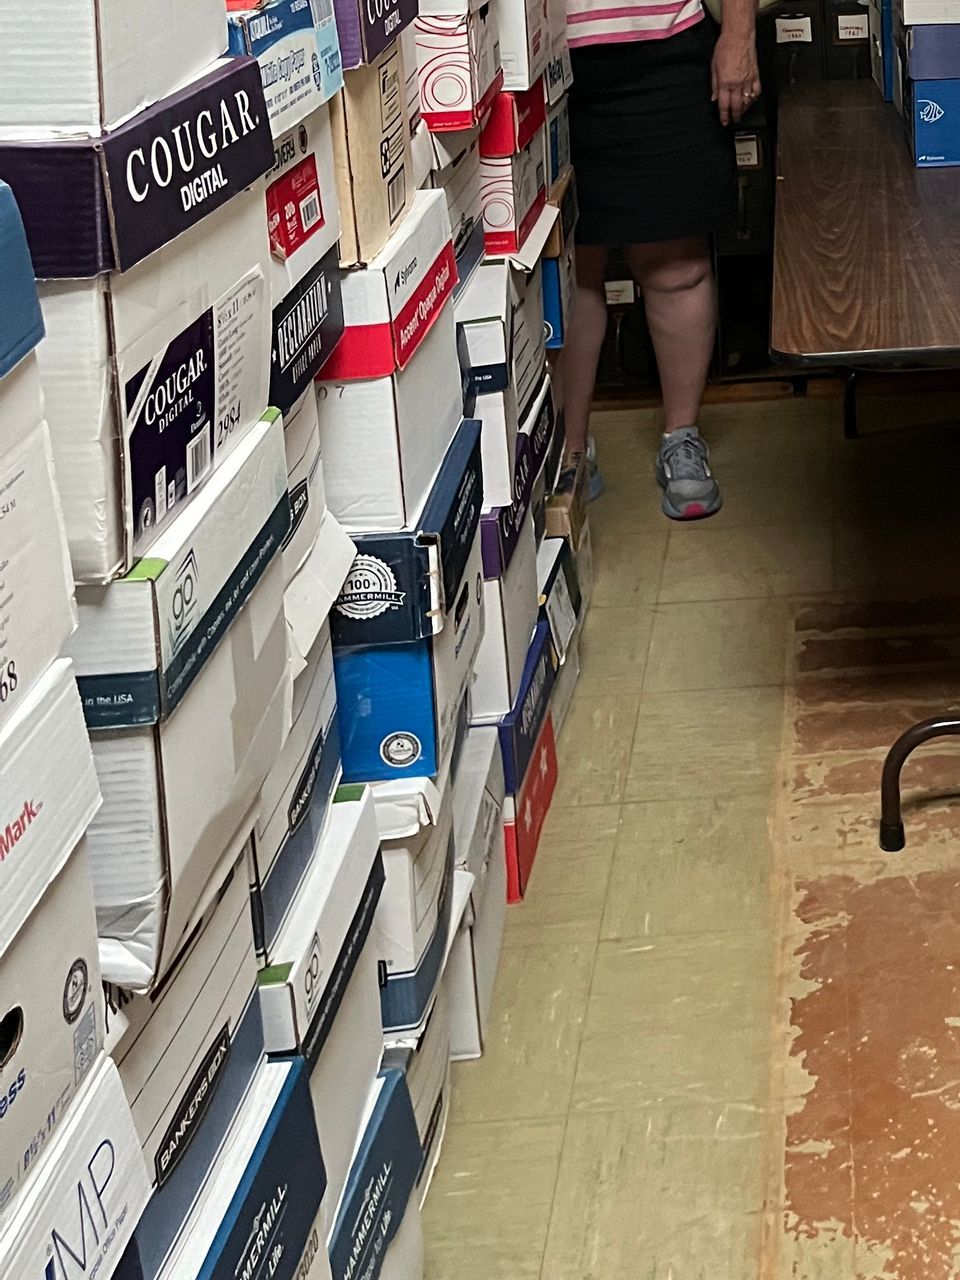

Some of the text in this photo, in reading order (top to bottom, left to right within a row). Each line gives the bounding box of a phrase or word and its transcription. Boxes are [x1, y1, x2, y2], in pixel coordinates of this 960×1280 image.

[180, 163, 228, 212] DIGITAL
[278, 275, 328, 368] DECLARATION
[158, 389, 195, 434] DIGITAL
[173, 574, 194, 631] go
[97, 696, 111, 705] the
[113, 693, 133, 704] USA
[161, 1077, 208, 1171] BANKERS
